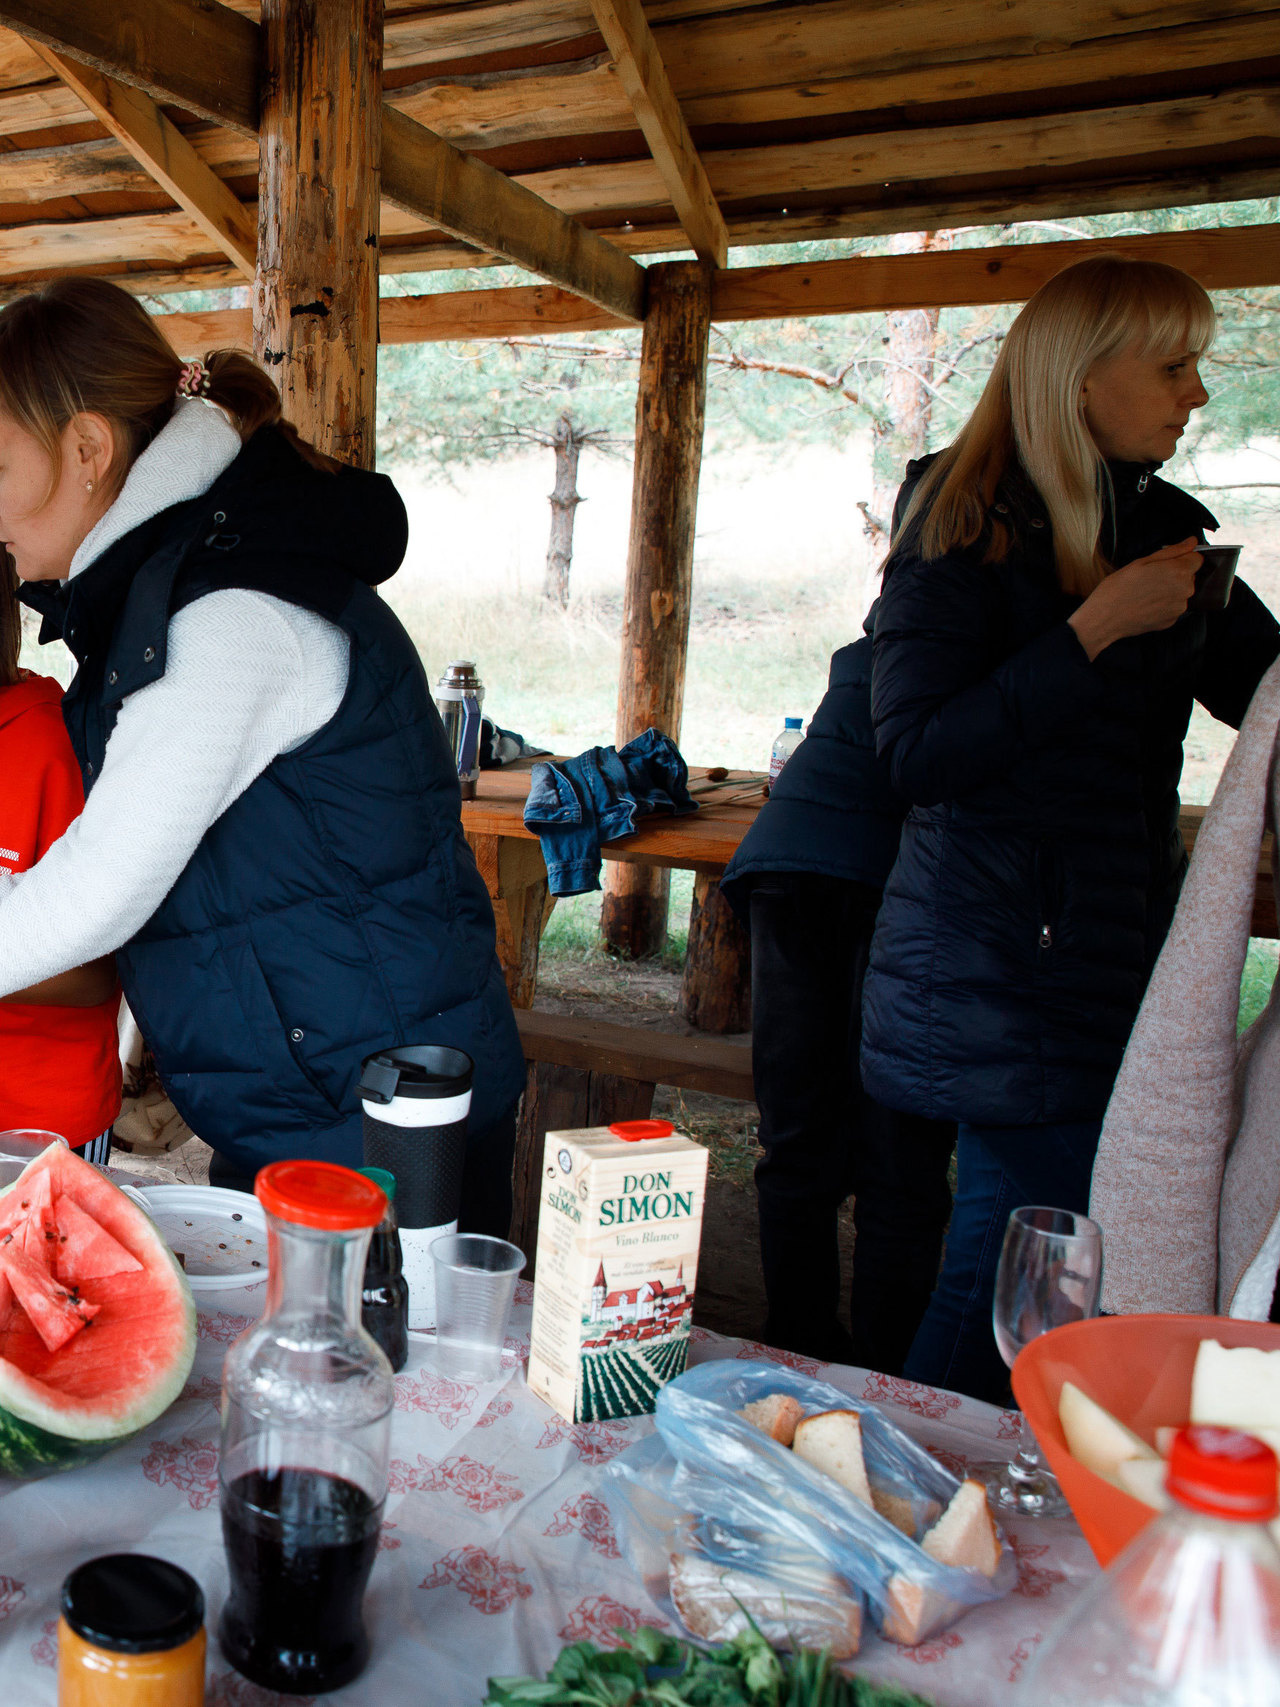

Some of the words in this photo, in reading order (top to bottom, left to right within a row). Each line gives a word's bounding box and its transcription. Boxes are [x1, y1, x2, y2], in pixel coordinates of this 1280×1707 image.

[622, 1171, 672, 1194] DON
[559, 1186, 577, 1204] DON
[547, 1192, 582, 1224] SIMON
[598, 1191, 694, 1227] SIMON
[616, 1234, 639, 1247] Vino
[642, 1231, 680, 1244] Blanco
